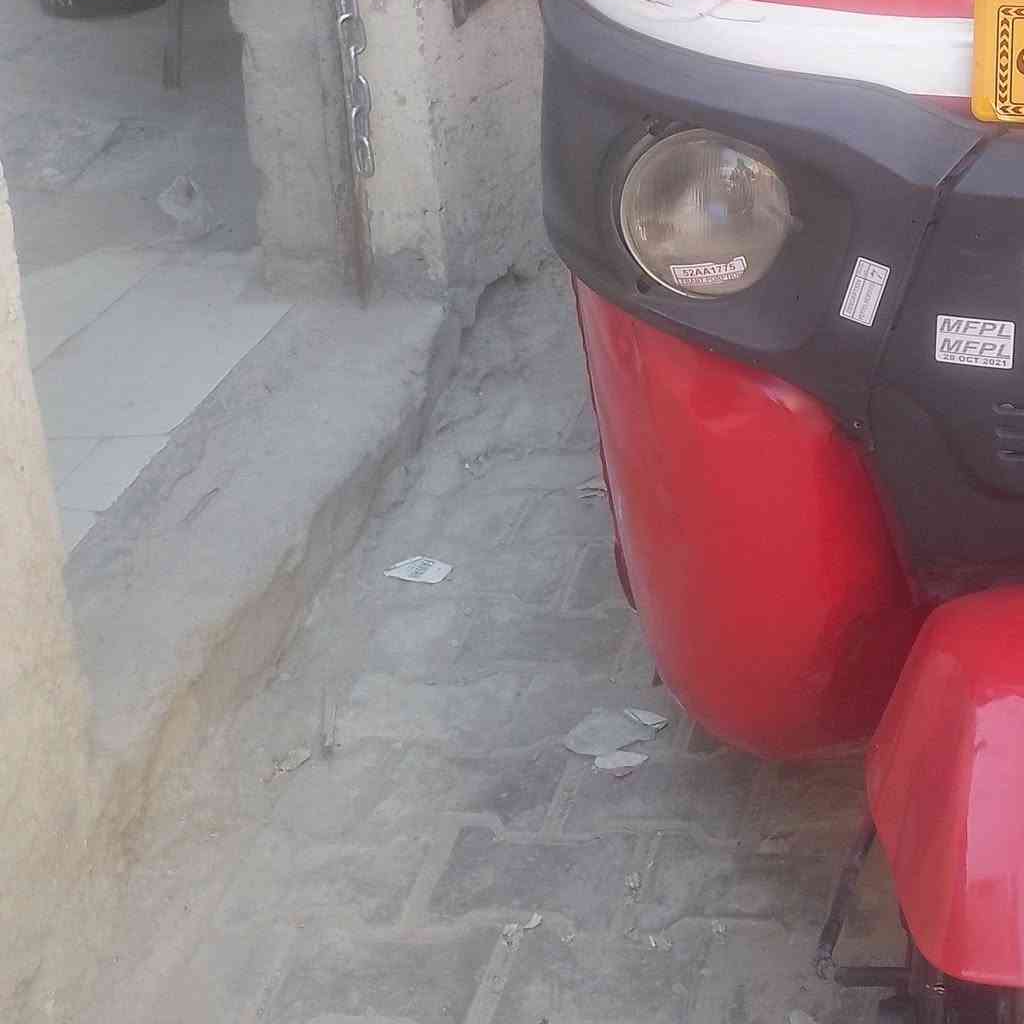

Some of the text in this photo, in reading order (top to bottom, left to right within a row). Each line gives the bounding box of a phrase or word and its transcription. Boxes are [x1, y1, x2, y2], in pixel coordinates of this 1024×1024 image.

[940, 317, 1012, 337] MFPL
[940, 337, 1011, 358] MFPL
[958, 355, 981, 364] OCT
[983, 357, 1007, 367] 2021
